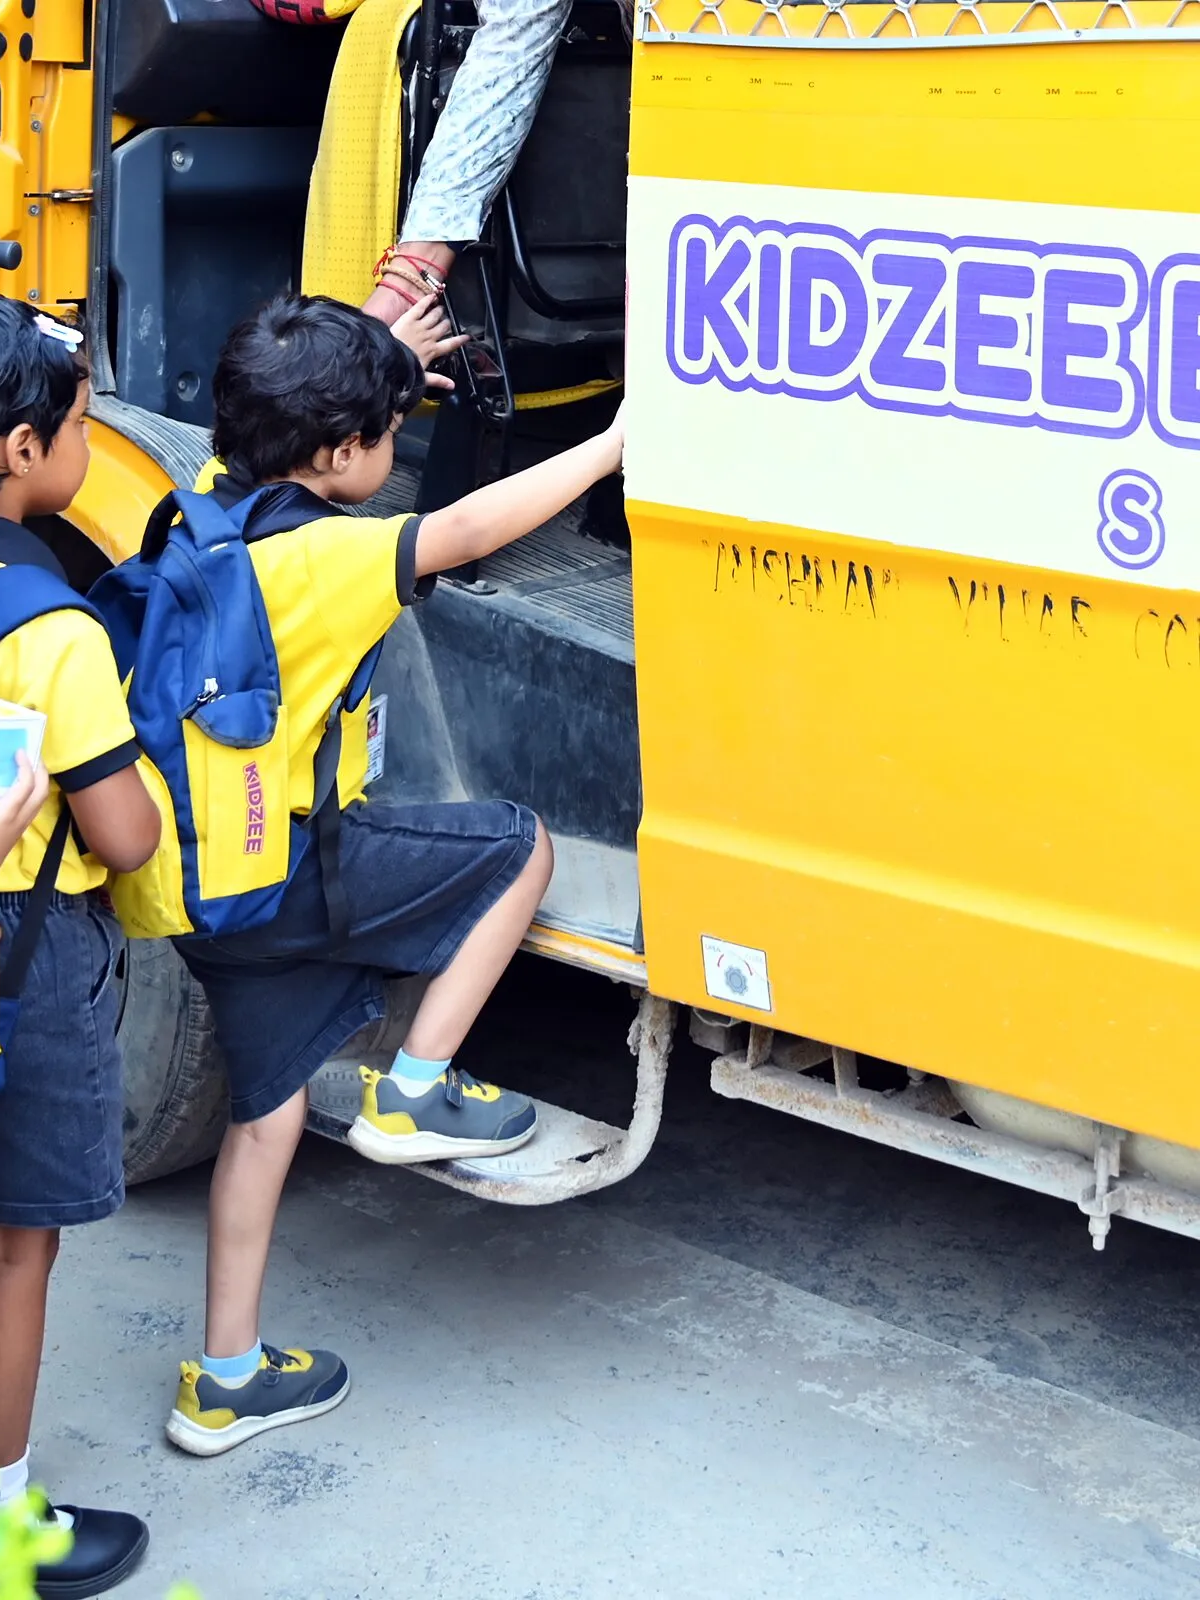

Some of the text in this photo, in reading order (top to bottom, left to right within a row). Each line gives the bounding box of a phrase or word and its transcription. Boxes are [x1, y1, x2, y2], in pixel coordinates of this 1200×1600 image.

[667, 213, 1148, 440] KIDZEE
[1097, 468, 1166, 570] S
[244, 761, 264, 854] KIDZEE
